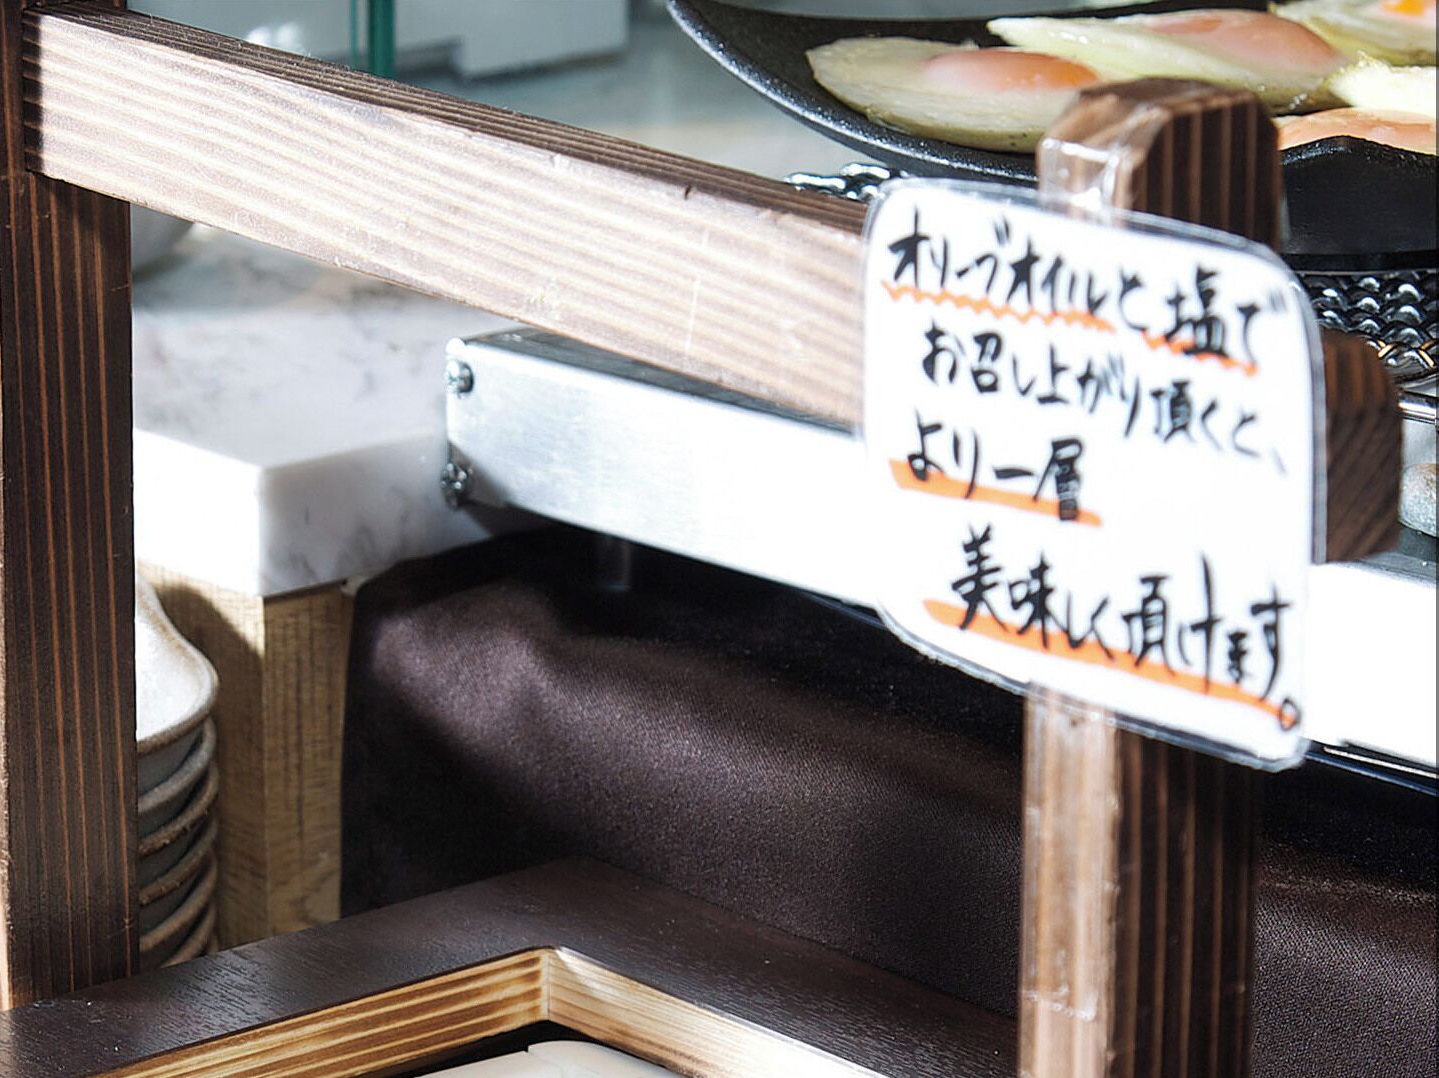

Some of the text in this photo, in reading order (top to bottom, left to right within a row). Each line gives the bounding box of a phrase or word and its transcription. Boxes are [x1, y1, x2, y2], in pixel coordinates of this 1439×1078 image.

[907, 409, 1083, 521] より一層
[951, 522, 1302, 731] 美味しく頂けます。
